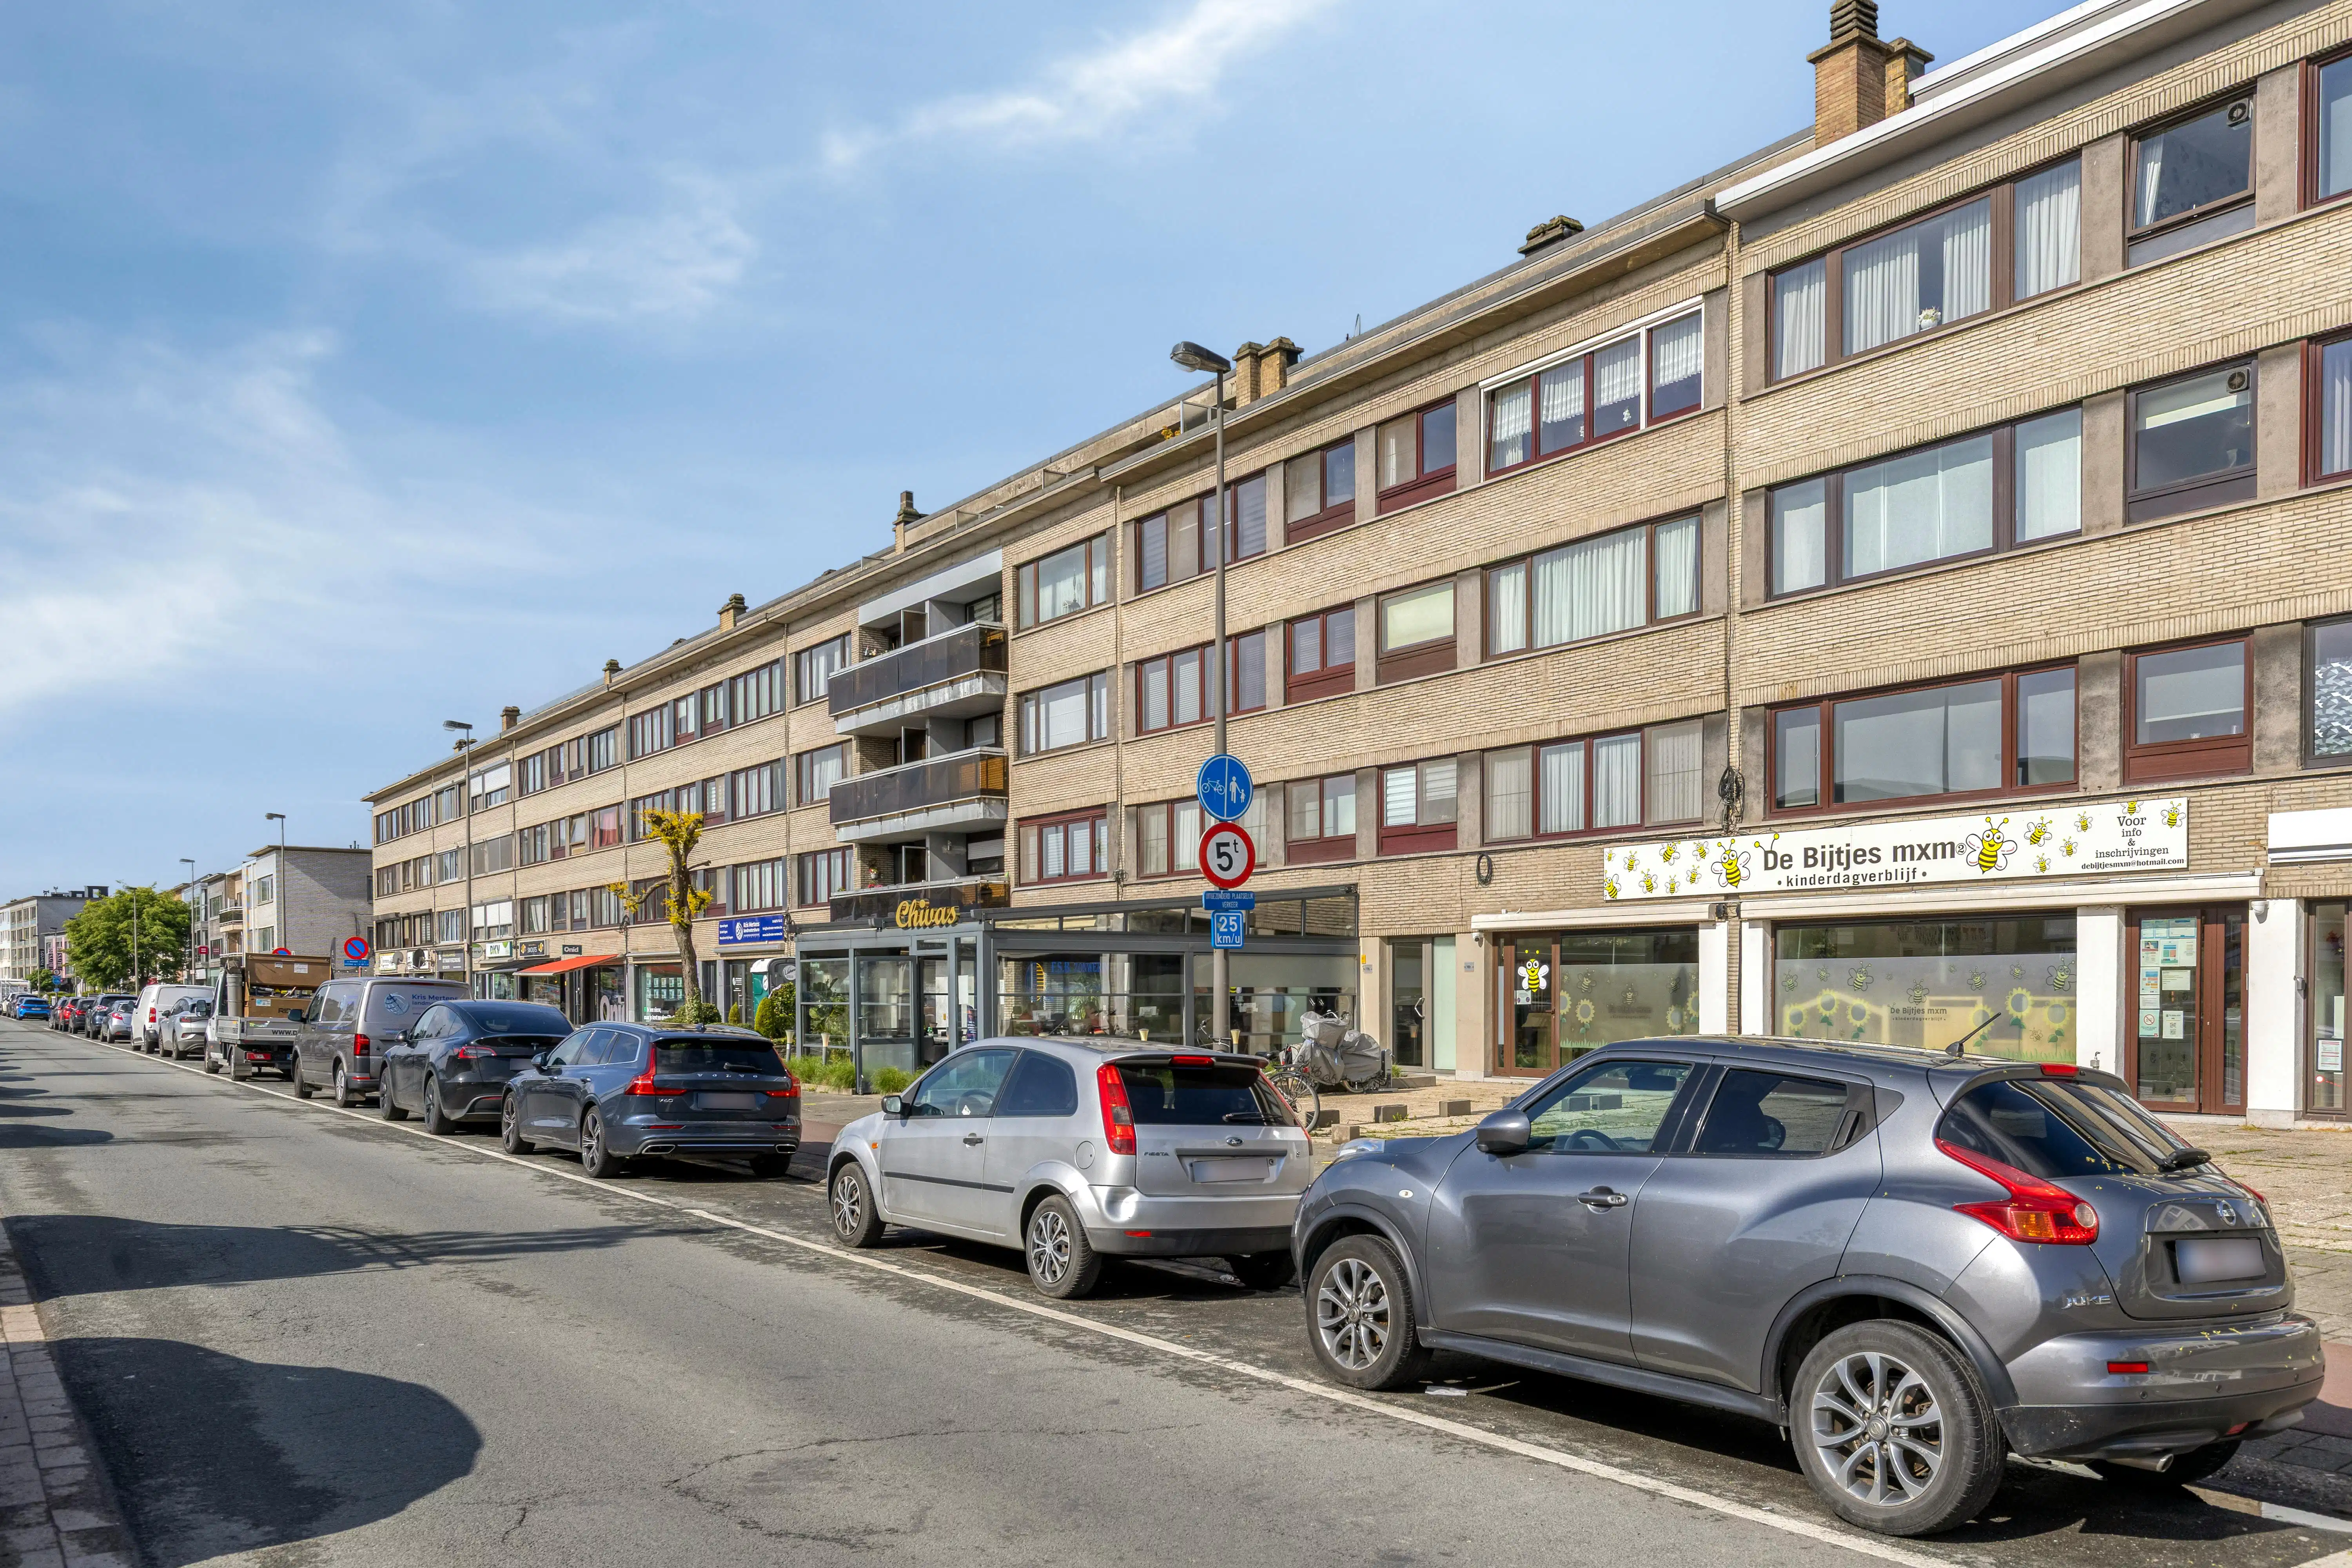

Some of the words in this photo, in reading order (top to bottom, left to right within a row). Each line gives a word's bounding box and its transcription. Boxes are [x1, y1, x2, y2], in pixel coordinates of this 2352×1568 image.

[2117, 816, 2146, 826] Voor
[2122, 828, 2141, 837] info
[1764, 850, 1793, 871] De
[1804, 843, 1881, 872] Bijtjes
[1893, 842, 1955, 862] mxm
[2095, 847, 2169, 858] inschrijvingen
[2082, 858, 2184, 870] debijtjesmxm@hotmail.com
[1787, 867, 1917, 887] kinderdagverblijf
[896, 899, 956, 928] Chivas
[1219, 916, 1238, 932] 25
[1217, 933, 1240, 944] km/u
[490, 945, 500, 955] DKV
[1903, 1007, 1925, 1015] Bijtjes
[2060, 1295, 2111, 1309] JUKE
